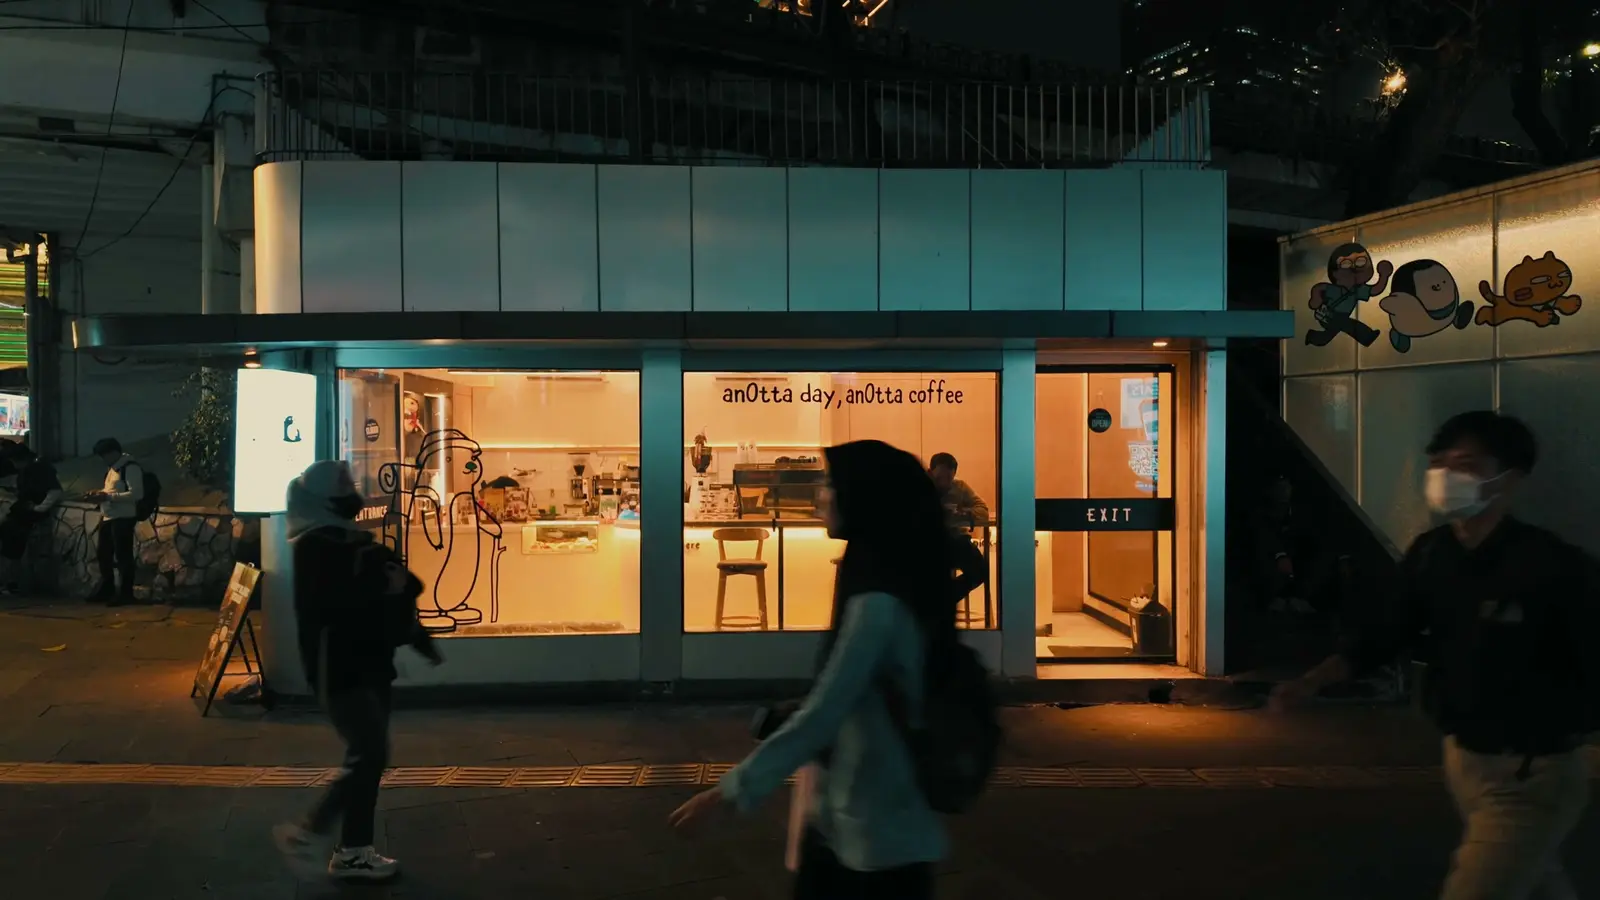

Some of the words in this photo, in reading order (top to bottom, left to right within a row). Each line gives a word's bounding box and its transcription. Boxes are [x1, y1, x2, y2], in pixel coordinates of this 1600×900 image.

[800, 383, 842, 410] day,
[909, 379, 964, 404] coffee
[1086, 508, 1132, 522] EXIT
